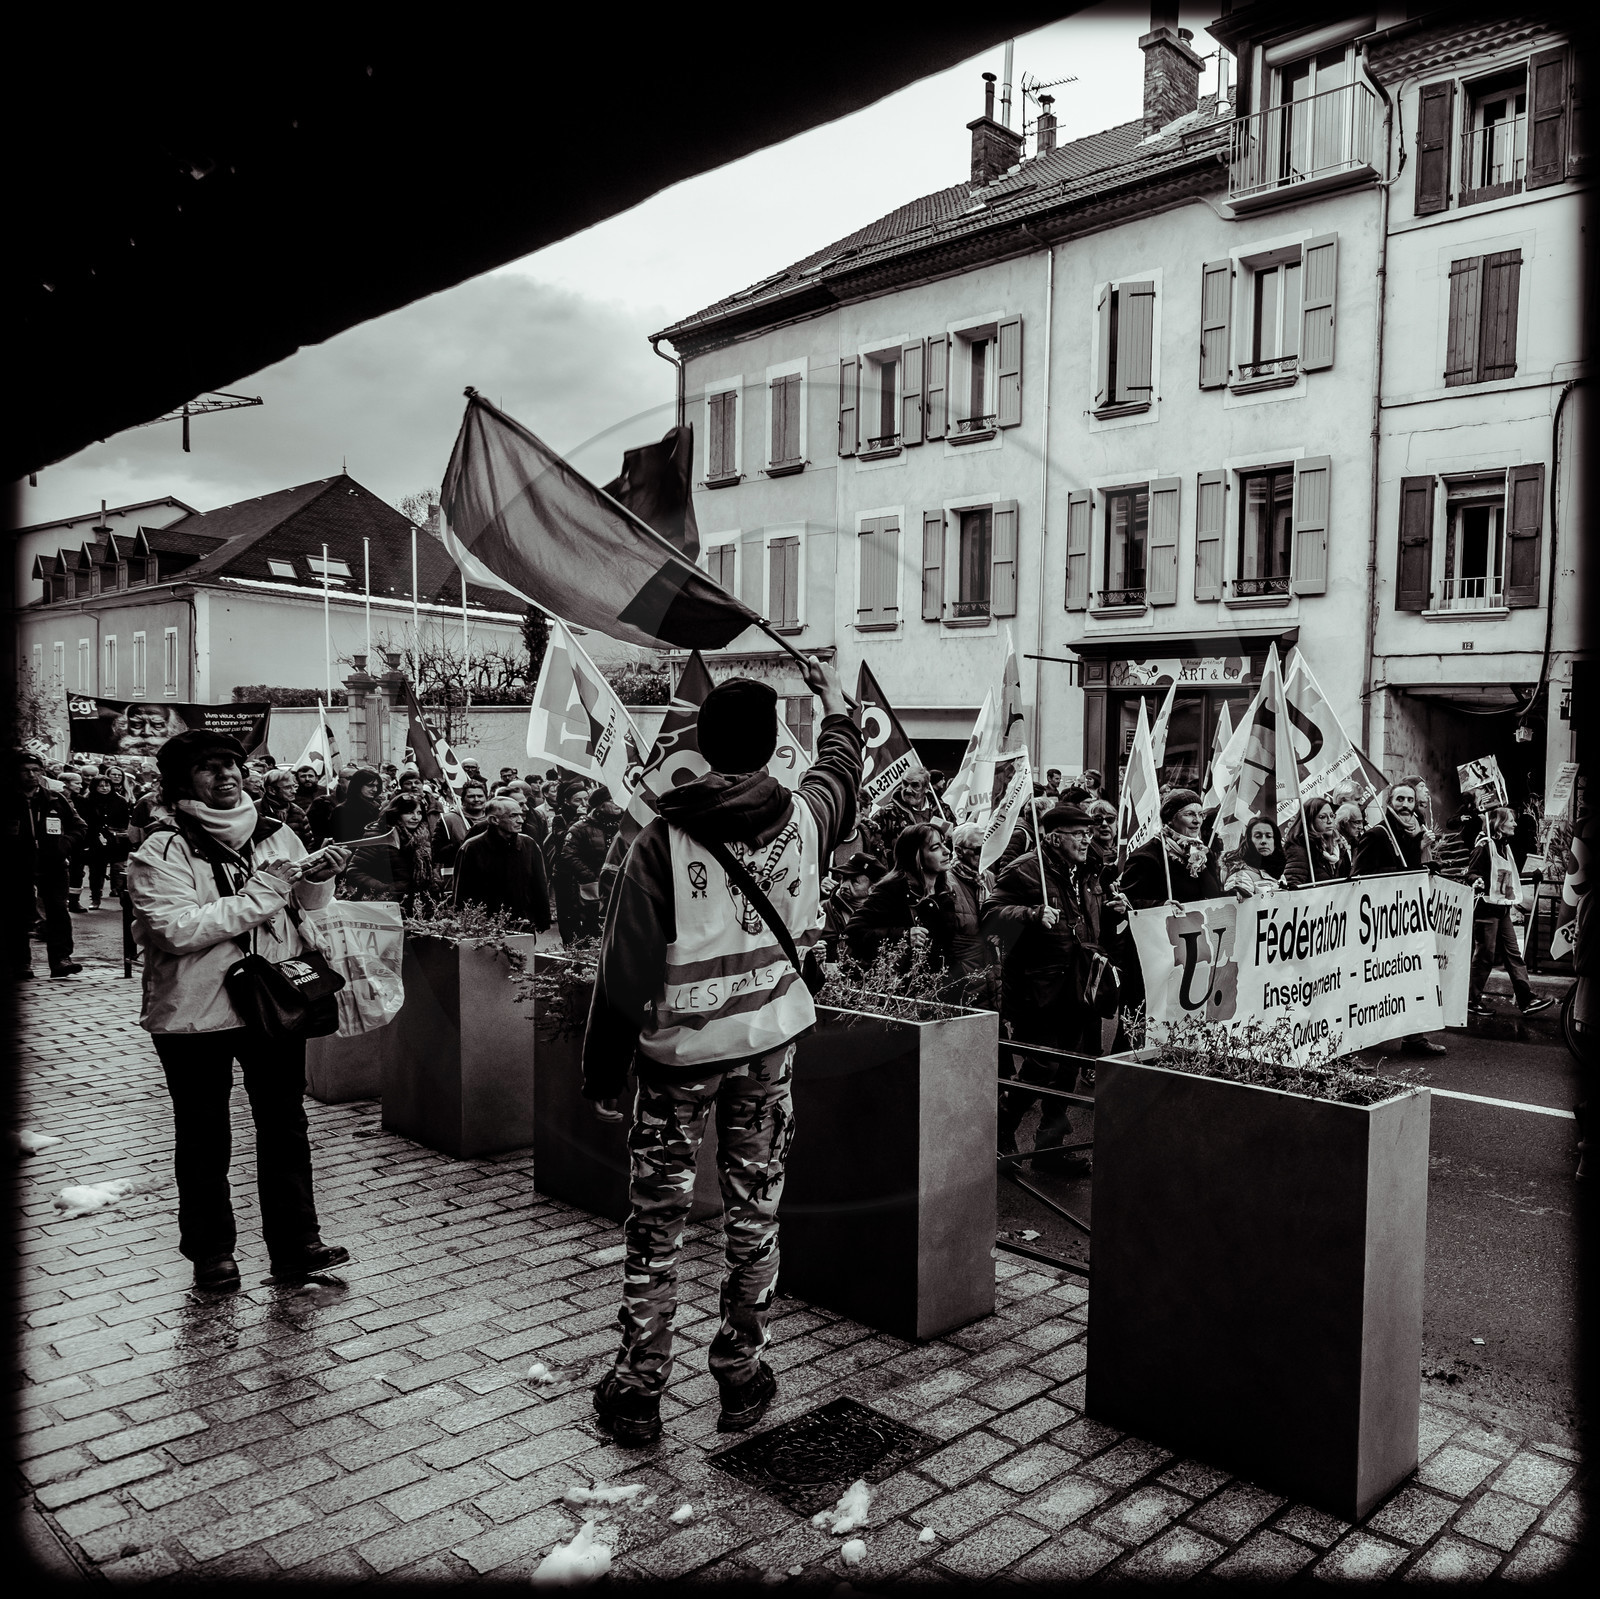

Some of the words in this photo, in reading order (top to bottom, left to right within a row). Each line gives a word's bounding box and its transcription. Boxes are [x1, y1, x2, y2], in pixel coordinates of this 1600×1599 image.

[1178, 666, 1207, 681] ART
[1210, 669, 1219, 680] &
[69, 699, 98, 715] cgt
[1254, 900, 1348, 967] Fédération
[1363, 951, 1422, 984] Education
[674, 983, 719, 1010] LES
[1348, 993, 1406, 1029] Formation
